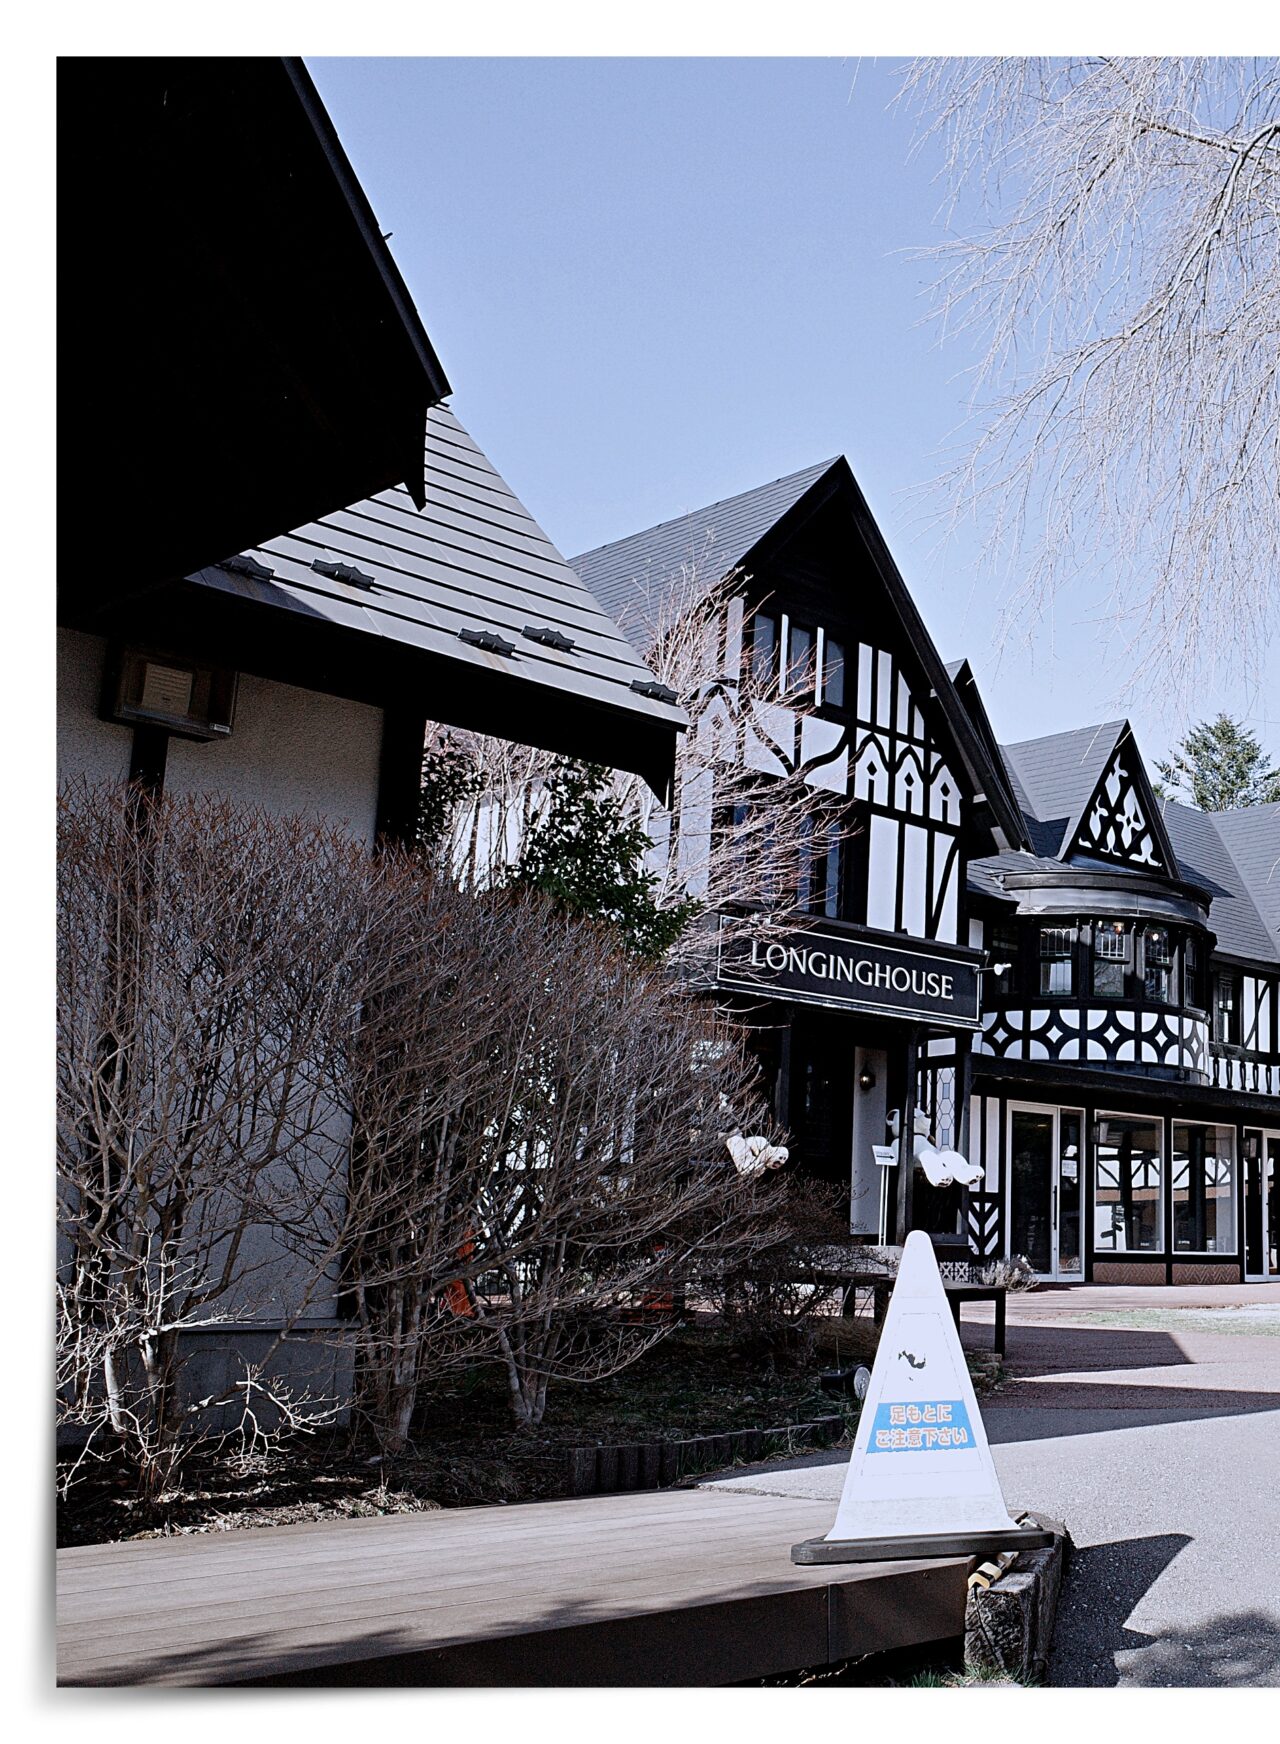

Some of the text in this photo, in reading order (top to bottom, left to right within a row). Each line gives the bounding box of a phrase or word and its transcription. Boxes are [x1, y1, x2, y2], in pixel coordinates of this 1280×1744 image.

[751, 940, 954, 1000] LONGINGHOUSE
[890, 1405, 952, 1424] 足もとに
[876, 1427, 968, 1448] ご注意下さい
